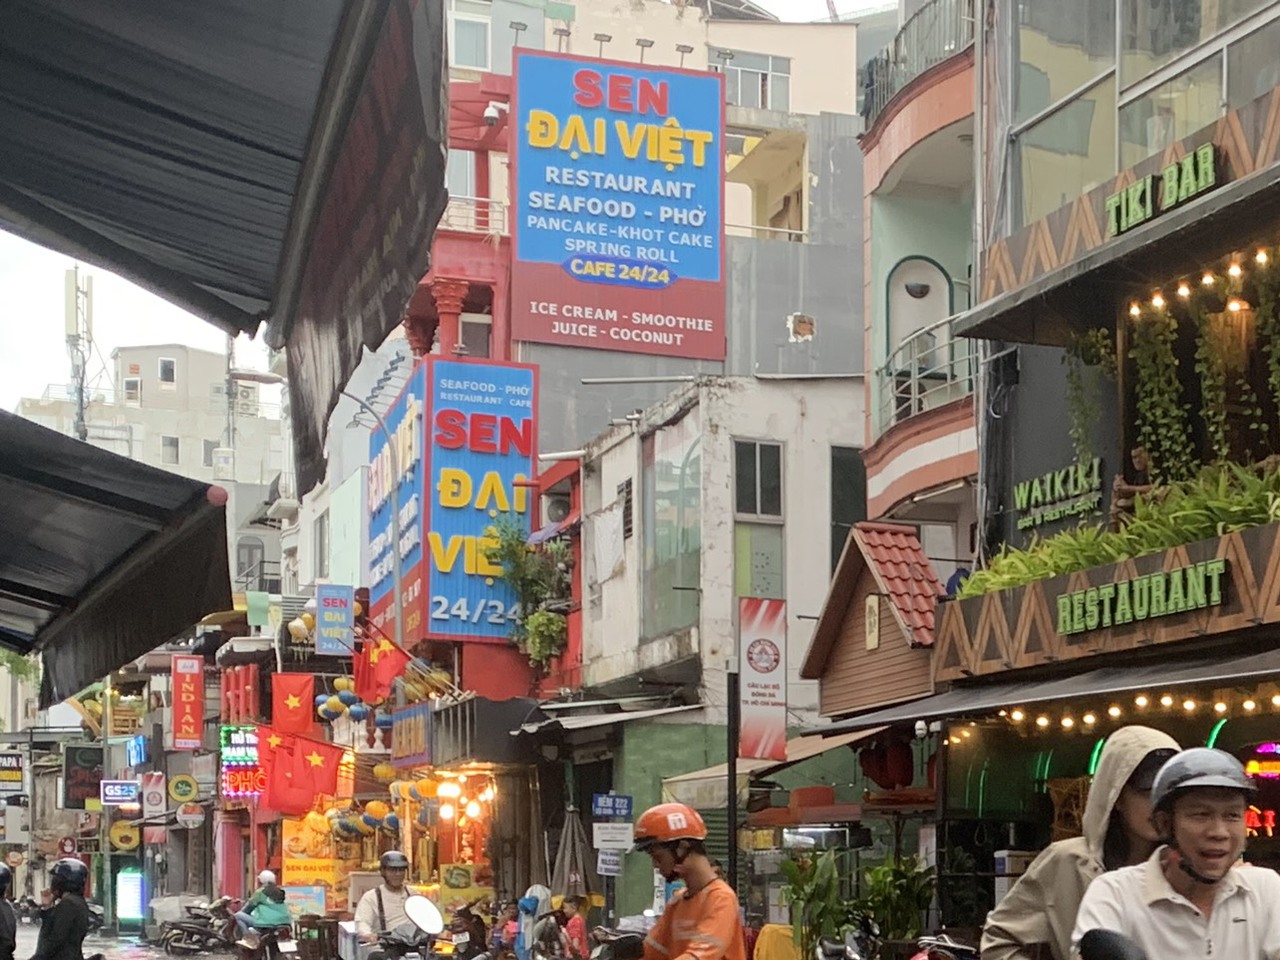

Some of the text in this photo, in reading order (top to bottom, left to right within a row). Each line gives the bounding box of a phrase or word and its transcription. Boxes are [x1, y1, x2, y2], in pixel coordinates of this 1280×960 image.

[573, 69, 669, 117] SEN
[526, 108, 713, 172] ĐẠI VIỆT
[545, 166, 696, 200] RESTAURANT
[1105, 141, 1216, 238] TIKI BAR
[528, 191, 636, 219] SEAFOOD
[659, 204, 707, 227] PHỞ
[565, 238, 679, 263] SPRING ROLL
[668, 231, 713, 248] CAKE
[570, 258, 670, 284] CAFE 24/24
[530, 301, 558, 316] ICE
[562, 304, 618, 322] CREAM
[631, 311, 713, 332] SMOOTHIE
[551, 321, 597, 338] JUICE
[609, 327, 684, 346] COCONUT
[440, 379, 496, 393] SEAFOOD
[440, 392, 503, 405] RESTAURANT
[435, 408, 532, 458] SEN
[436, 467, 527, 518] ĐẠI
[1014, 457, 1102, 510] WAIKIKI
[428, 525, 520, 586] VIỆ
[322, 597, 348, 608] SEN
[1057, 559, 1226, 636] RESTAURANT
[181, 674, 196, 734] INDIAN
[105, 785, 136, 796] GS25
